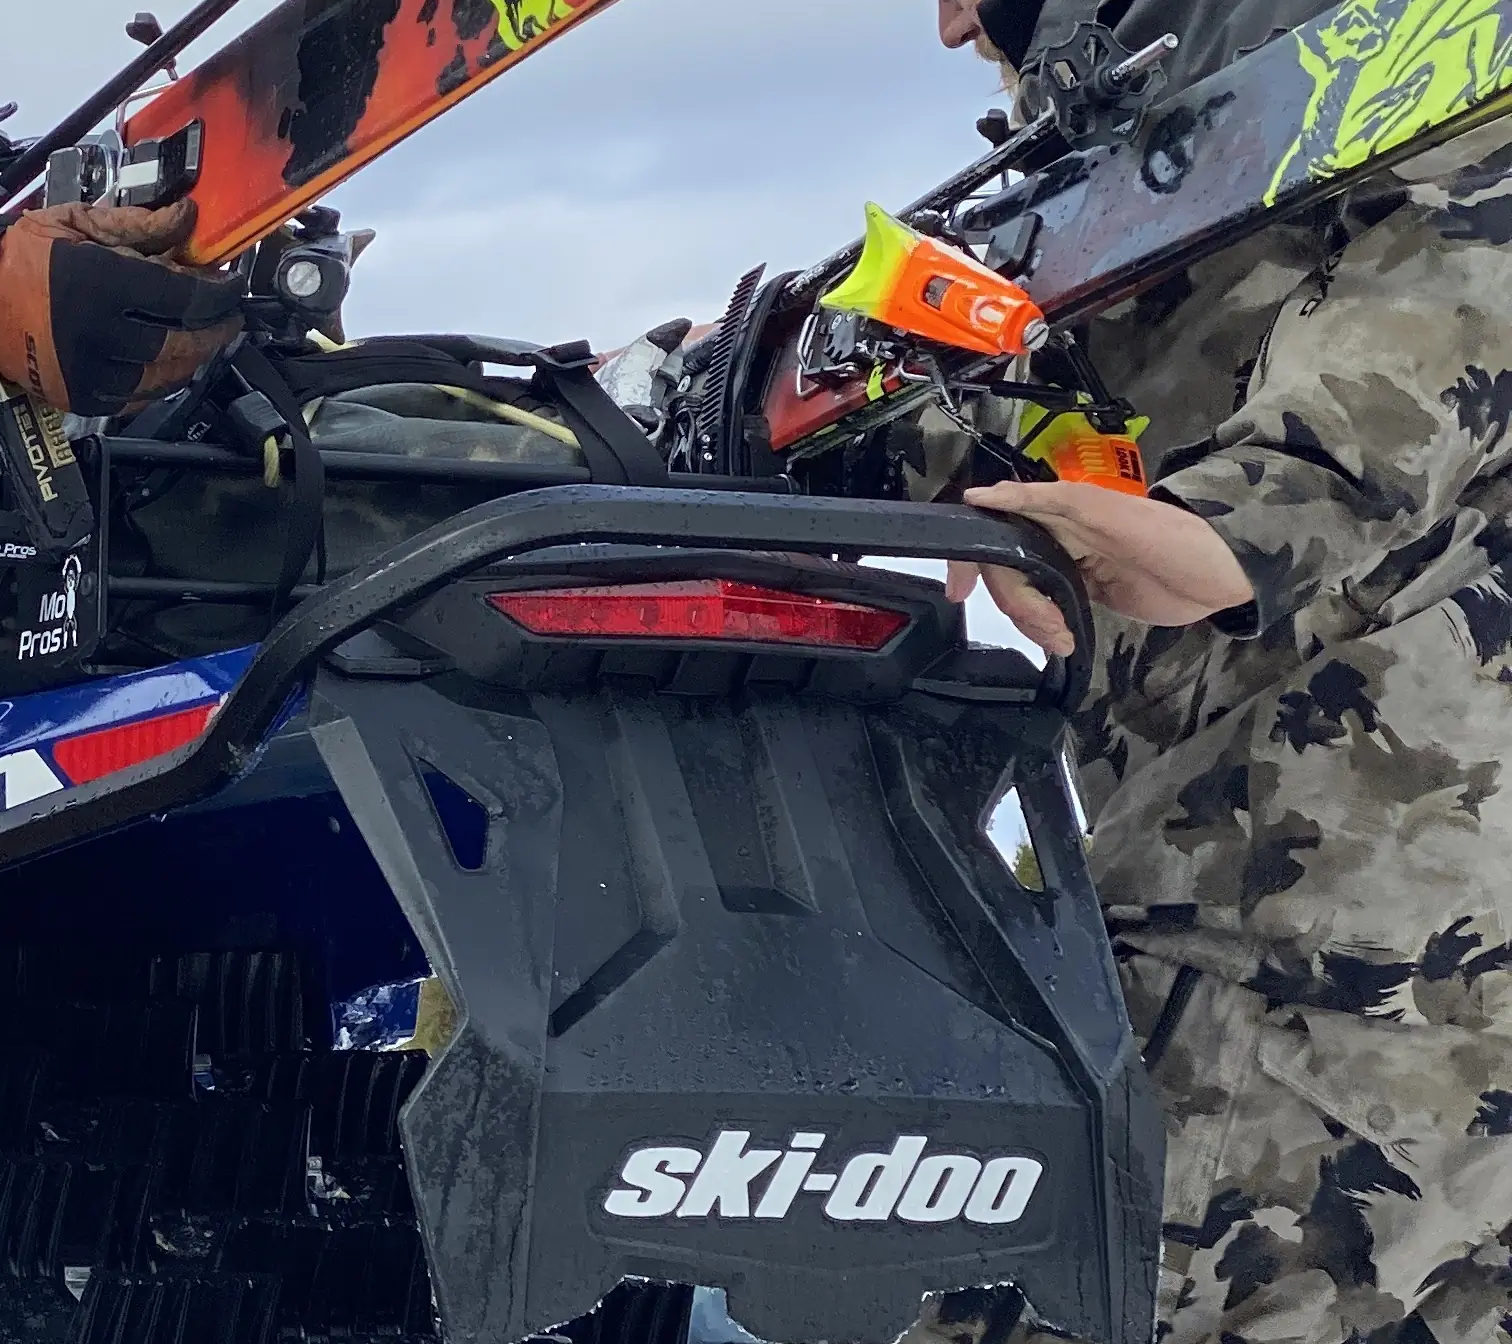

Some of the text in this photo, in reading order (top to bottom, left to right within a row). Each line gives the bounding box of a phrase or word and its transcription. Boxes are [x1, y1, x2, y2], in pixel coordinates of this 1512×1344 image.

[3, 542, 37, 556] Pros
[38, 591, 66, 623] Mo
[18, 627, 63, 661] Pros
[603, 1130, 1044, 1225] ski-doo
